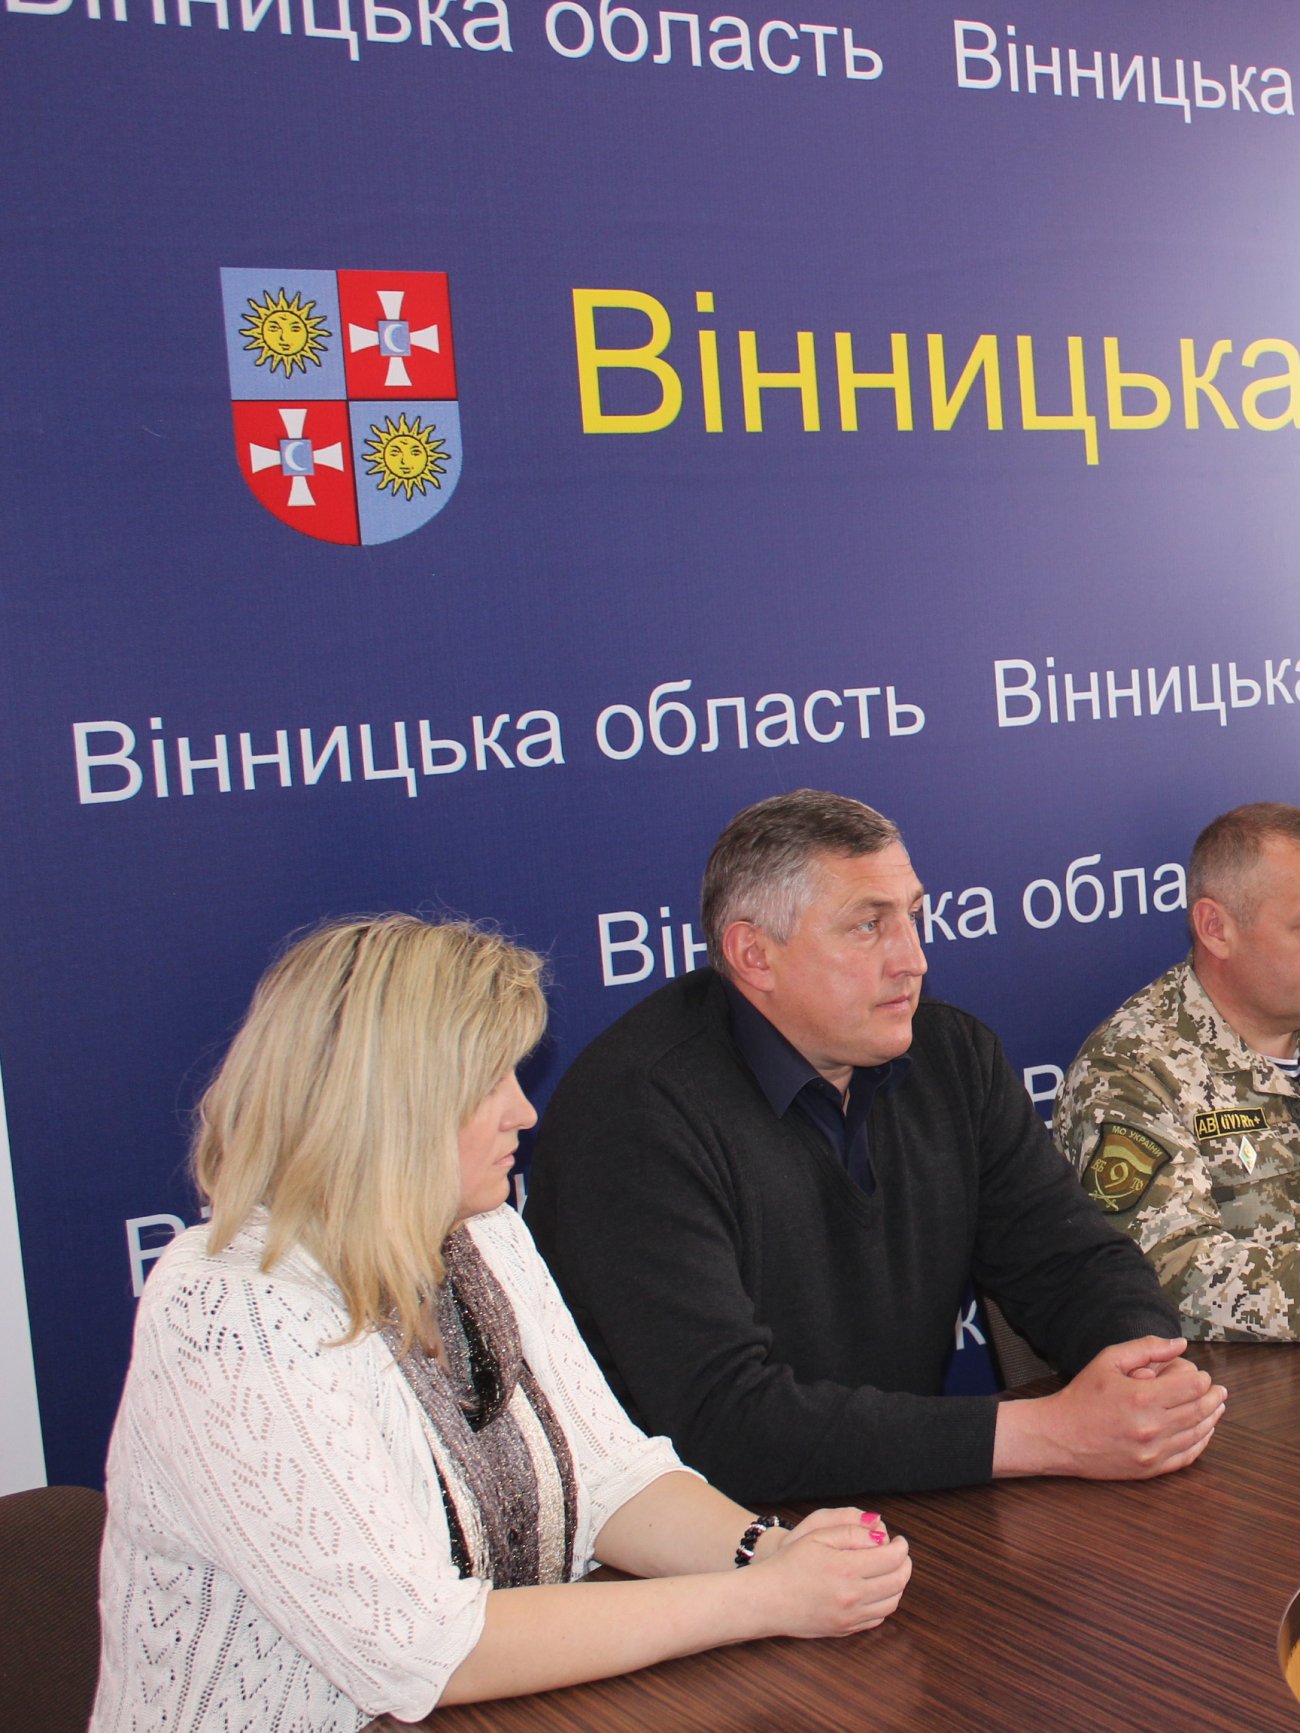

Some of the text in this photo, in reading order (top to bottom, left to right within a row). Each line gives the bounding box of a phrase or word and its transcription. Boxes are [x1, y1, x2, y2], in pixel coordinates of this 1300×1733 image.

[6, 0, 884, 80] ицька область
[953, 19, 1295, 124] Вінницька
[72, 679, 926, 805] Вінницька область
[1022, 853, 1188, 930] обла
[1112, 1125, 1164, 1157] МО УКРАЇНИ
[1199, 1117, 1217, 1135] AB
[1104, 1161, 1129, 1189] 9
